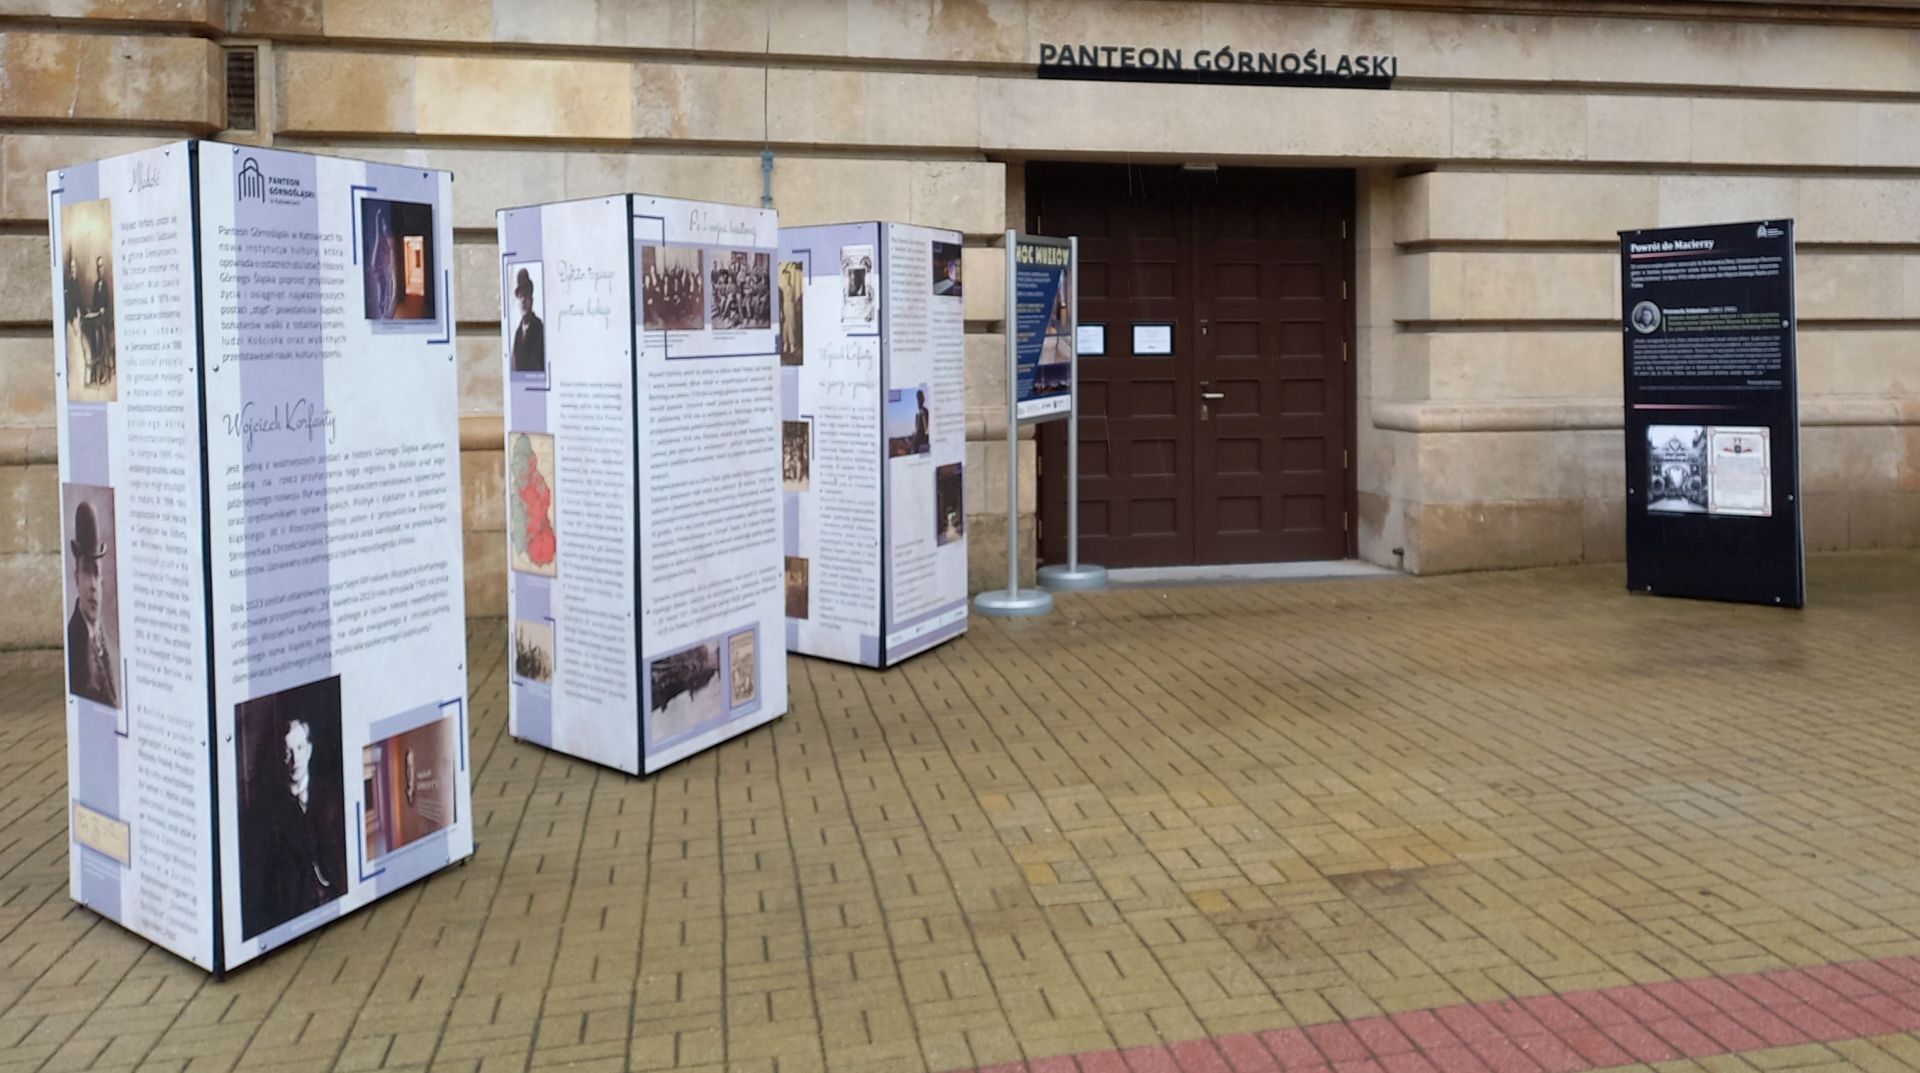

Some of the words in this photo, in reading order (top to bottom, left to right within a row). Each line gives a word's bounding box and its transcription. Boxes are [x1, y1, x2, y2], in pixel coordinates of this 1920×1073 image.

[1040, 42, 1182, 70] PANTEON
[1630, 242, 1660, 253] Powrót
[1662, 240, 1673, 250] do
[1674, 239, 1715, 251] Macierzy
[222, 402, 280, 452] Wojciech
[286, 399, 335, 444] Korfanty
